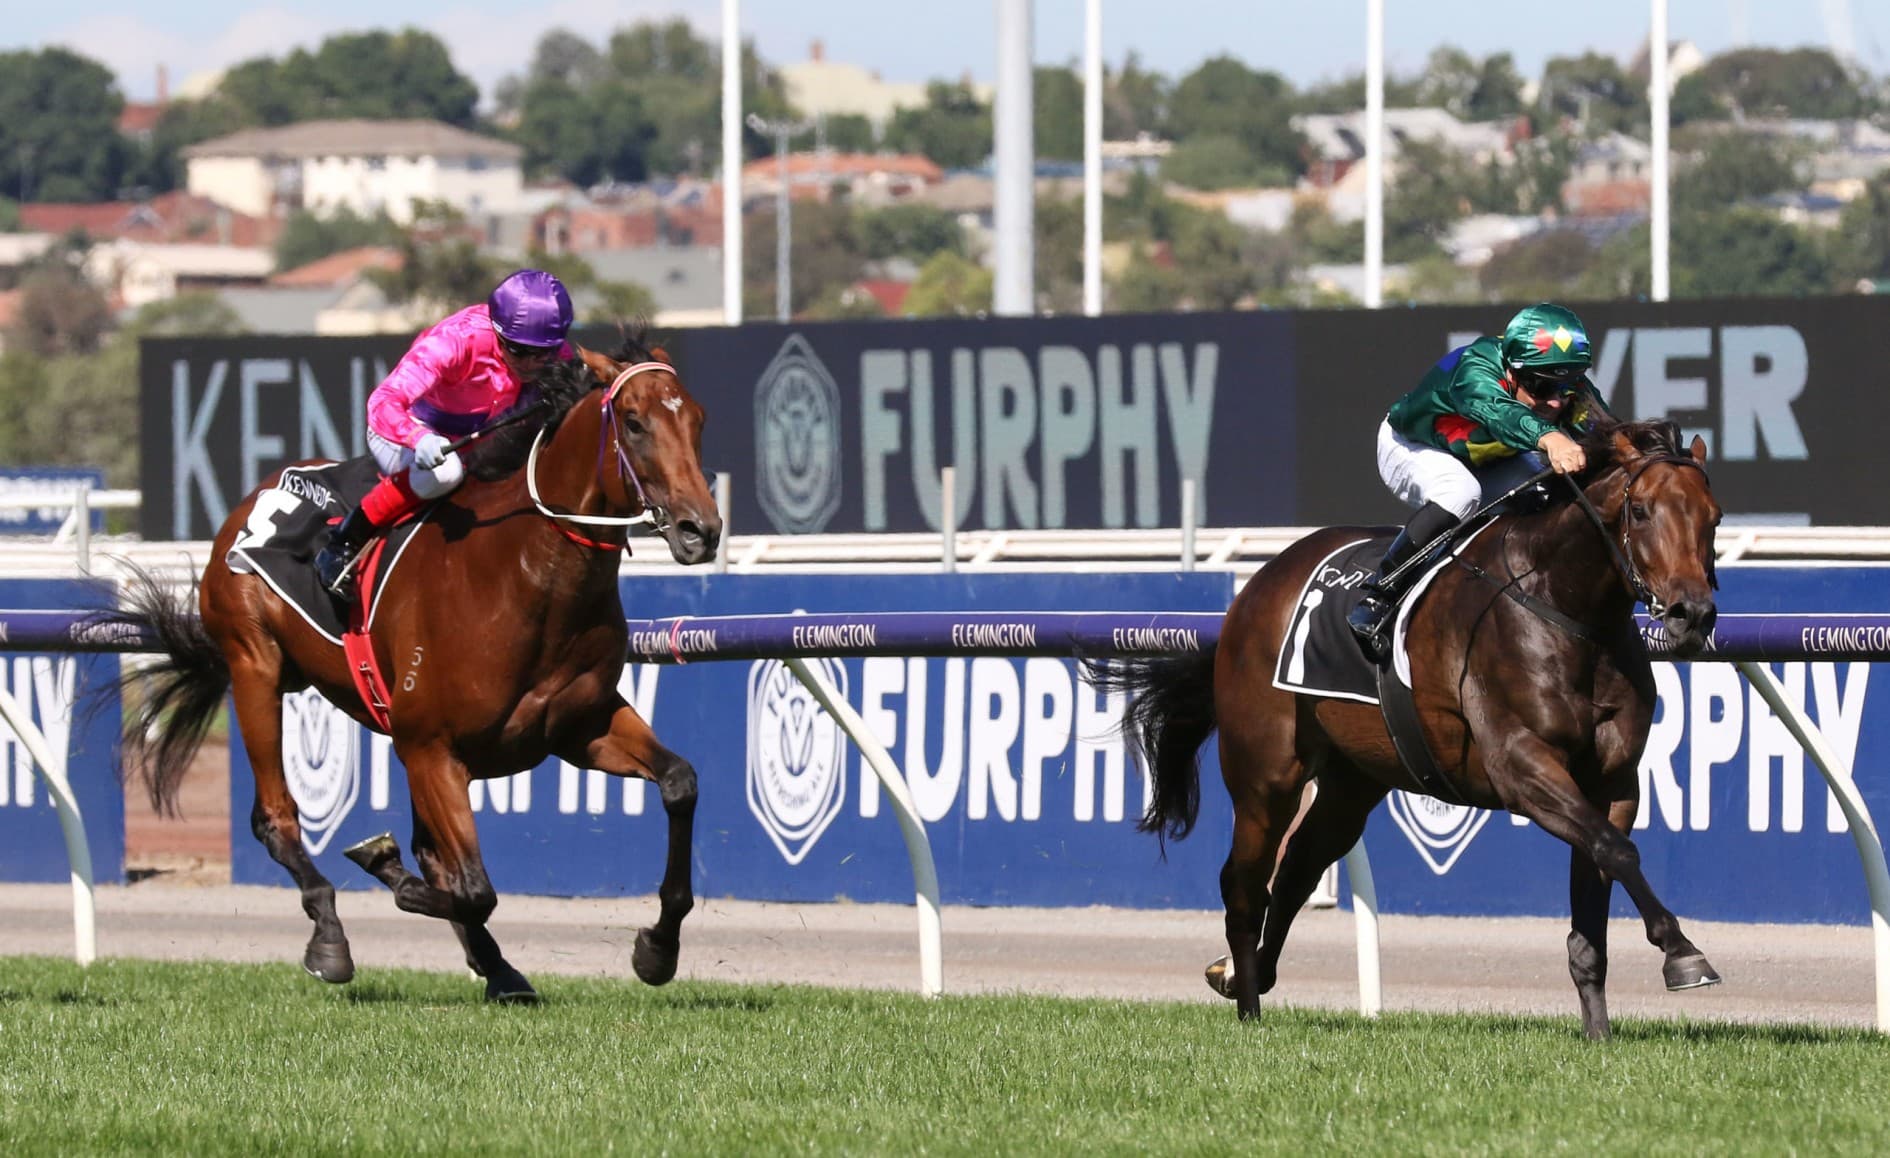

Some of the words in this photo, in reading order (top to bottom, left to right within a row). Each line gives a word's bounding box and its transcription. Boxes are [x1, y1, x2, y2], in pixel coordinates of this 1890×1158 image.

[861, 343, 1219, 530] FURPHY
[1448, 325, 1809, 460] ER
[172, 358, 391, 541] KEN
[236, 488, 302, 548] 5
[632, 629, 718, 653] FLEMINGTON
[792, 623, 876, 648] FLEMINGTON
[952, 623, 1037, 648] FLEMINGTON
[1112, 627, 1200, 651] FLEMINGTON
[1286, 588, 1324, 685] 1
[860, 656, 1157, 823] FURPH
[1511, 661, 1870, 834] RPHY
